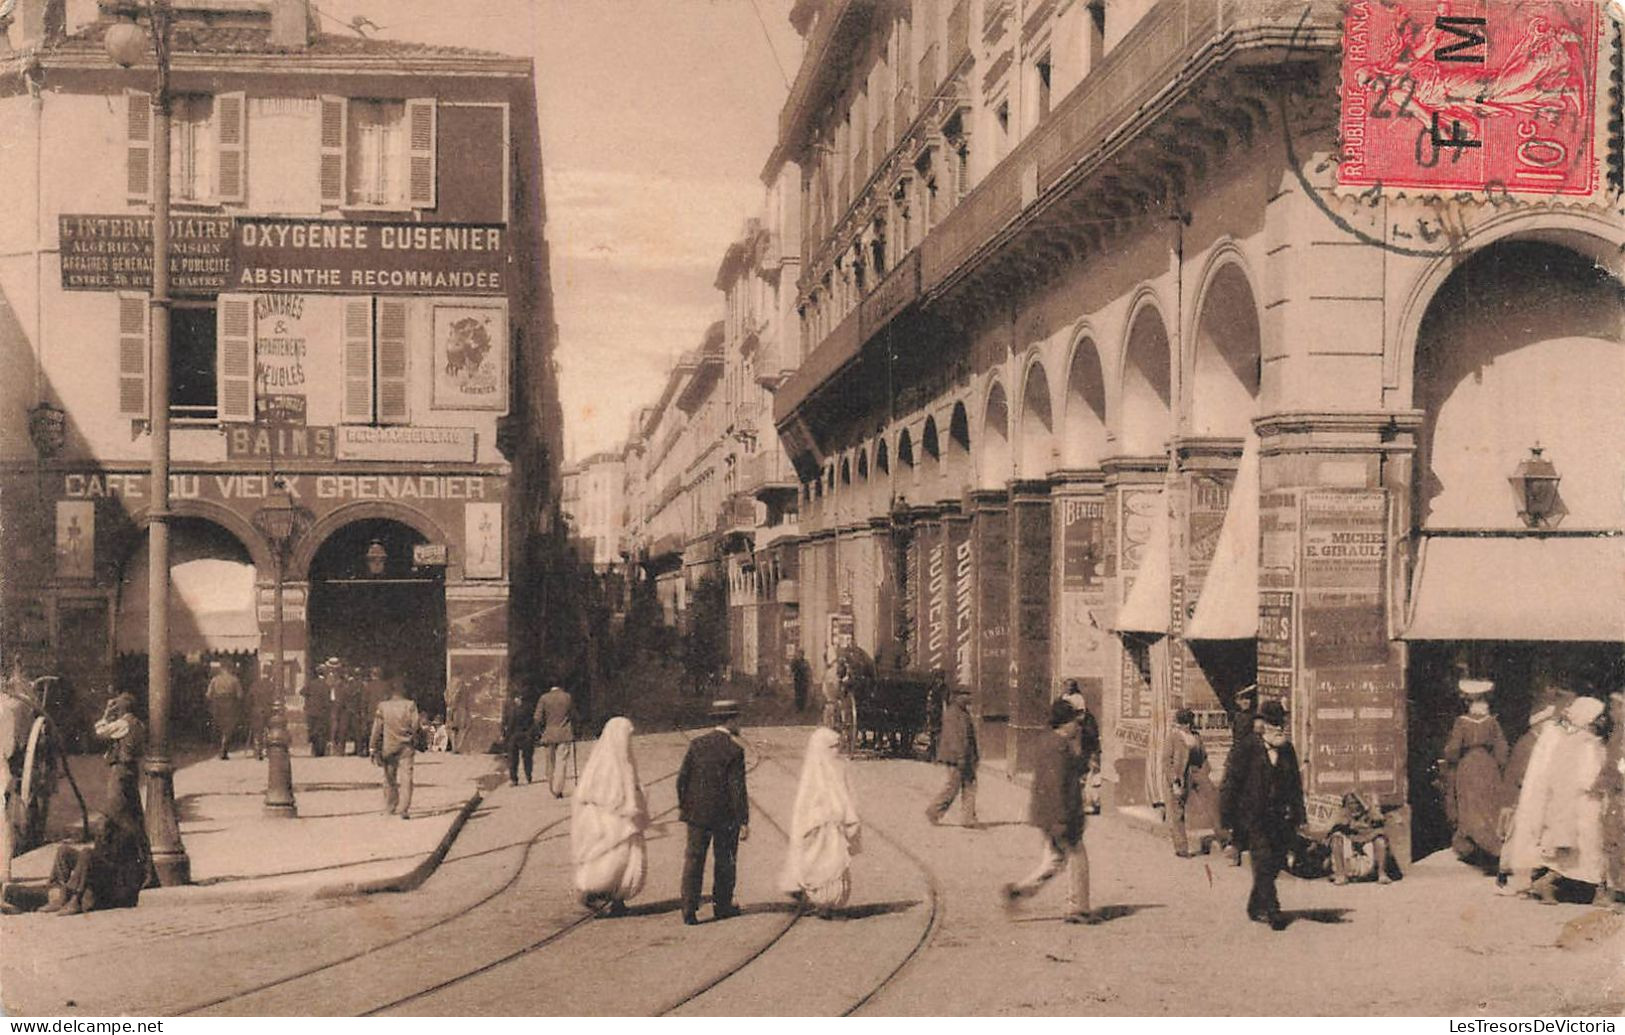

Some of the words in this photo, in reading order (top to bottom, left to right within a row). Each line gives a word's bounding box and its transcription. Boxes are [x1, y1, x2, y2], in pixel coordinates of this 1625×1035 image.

[1434, 16, 1487, 63] M
[1431, 111, 1483, 149] F
[380, 227, 501, 251] CUSENIER
[240, 267, 342, 286] ABSINTHE
[274, 320, 288, 334] &
[231, 426, 333, 459] BAINS
[316, 475, 485, 500] GRENADIER
